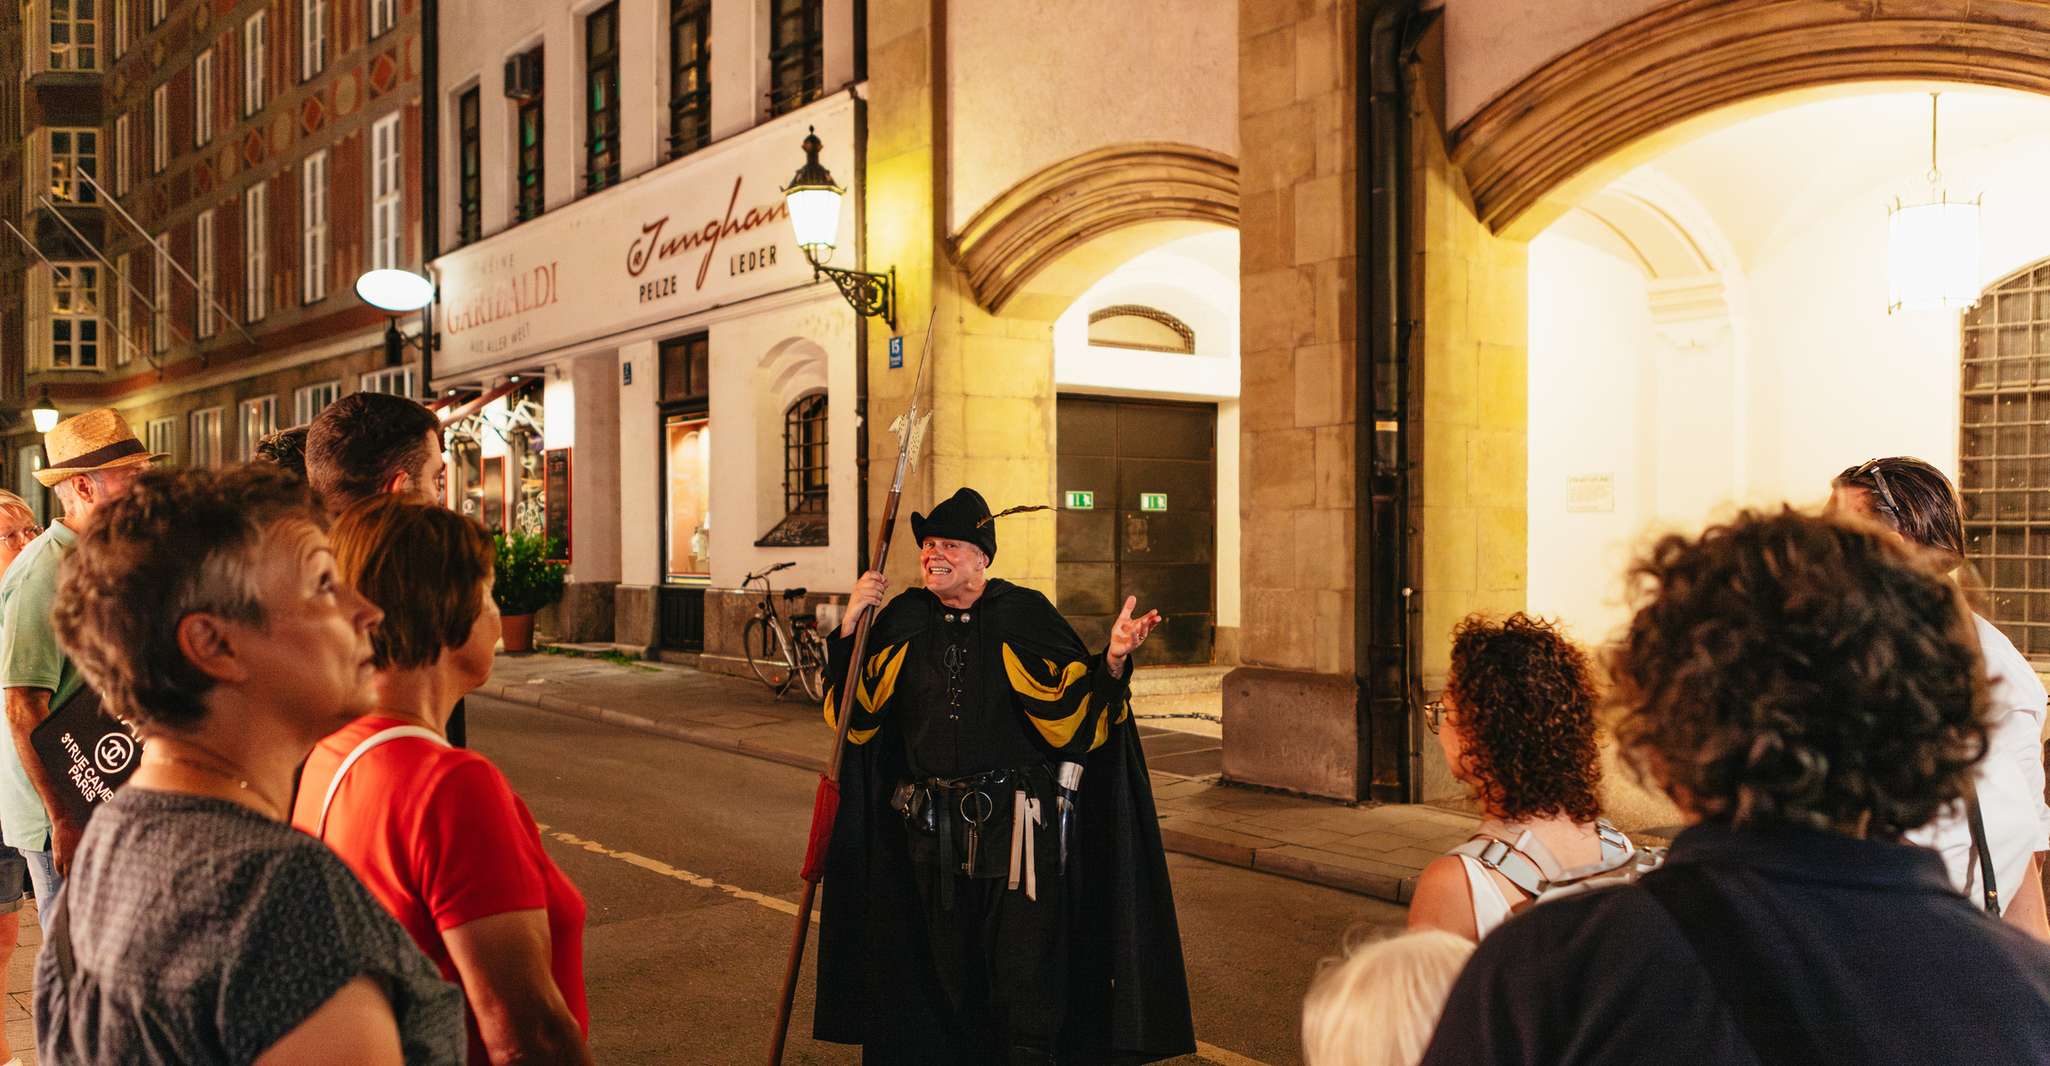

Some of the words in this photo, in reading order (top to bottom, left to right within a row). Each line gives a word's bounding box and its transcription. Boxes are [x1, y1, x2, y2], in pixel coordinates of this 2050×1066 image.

[627, 176, 790, 291] Junghan
[730, 245, 777, 276] LEDER
[640, 275, 677, 303] PELZE
[891, 338, 900, 354] 15
[61, 732, 74, 749] 31
[68, 743, 90, 771] RUE
[84, 767, 115, 803] CAMB
[68, 764, 97, 802] PARIS
